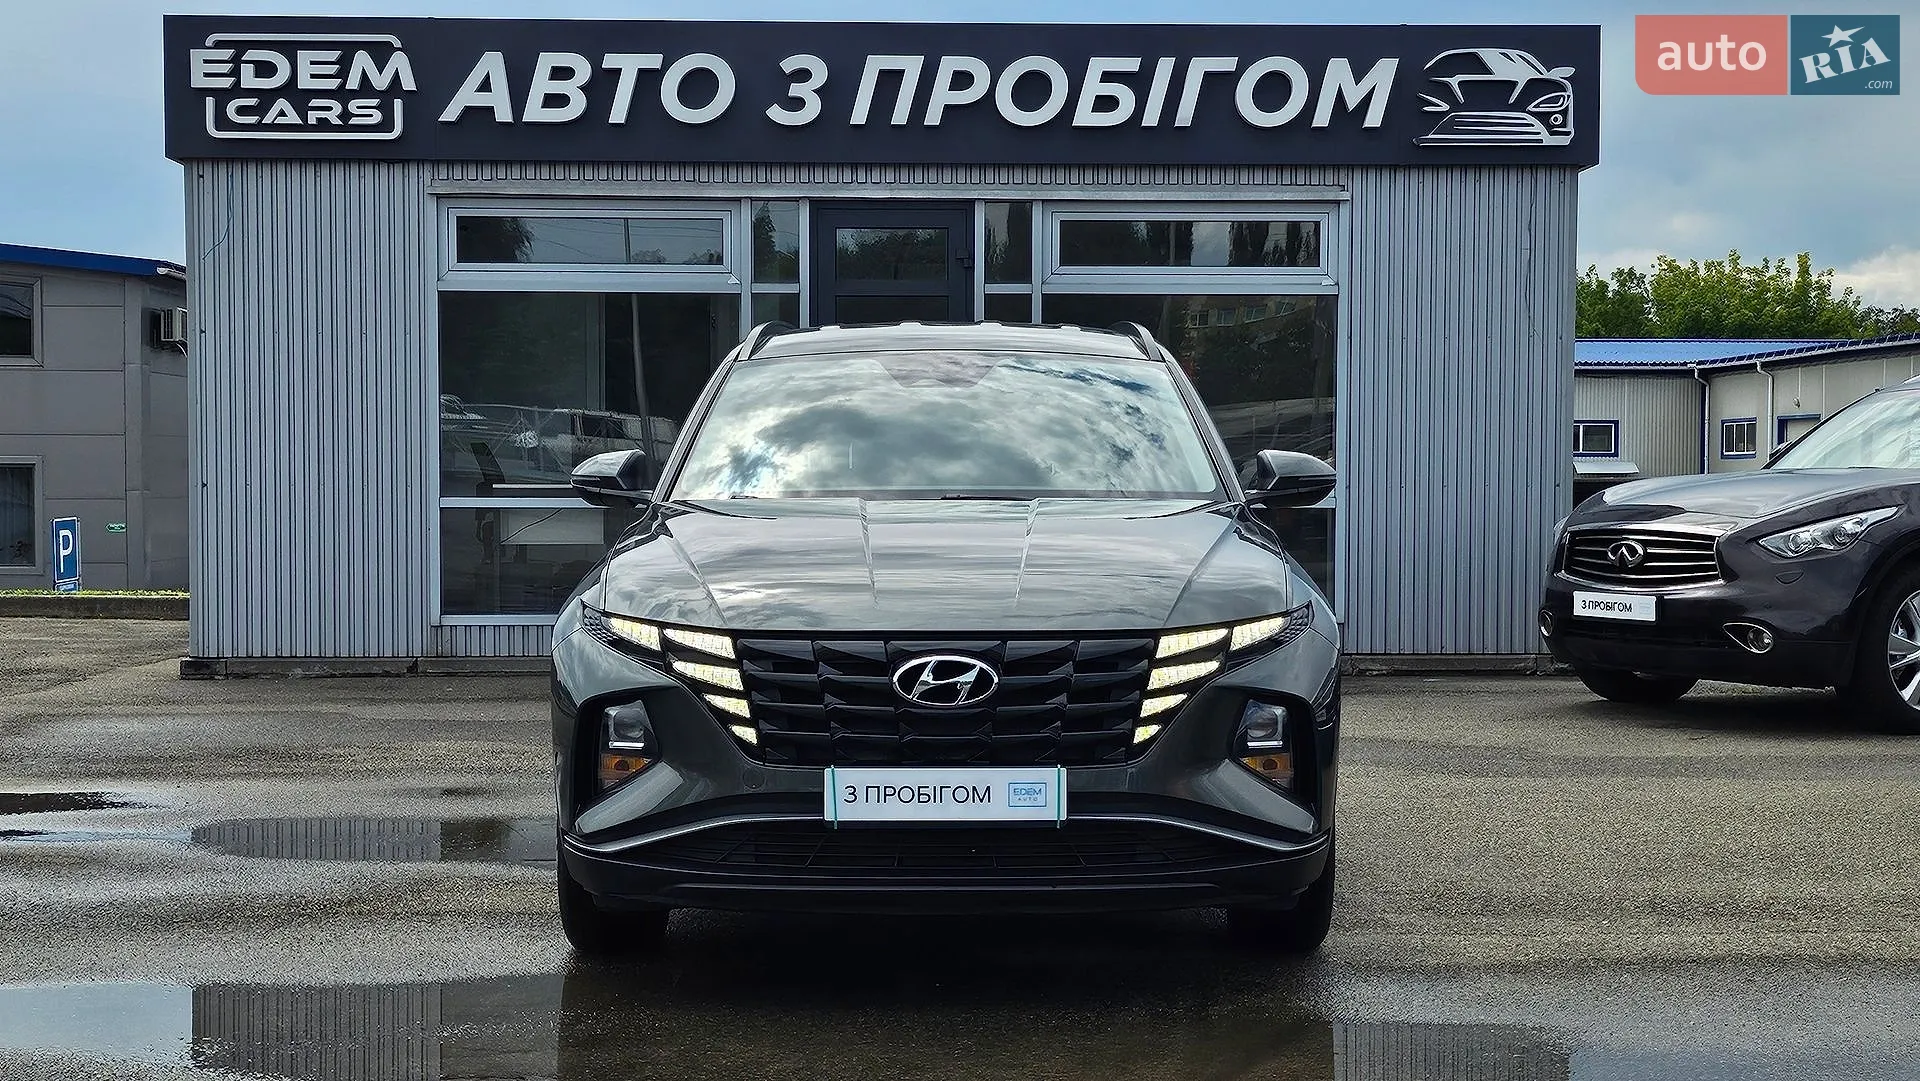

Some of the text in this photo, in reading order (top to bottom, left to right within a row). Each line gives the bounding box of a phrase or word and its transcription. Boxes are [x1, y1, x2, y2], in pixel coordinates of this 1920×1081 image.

[190, 48, 418, 92] EDEM
[438, 51, 1400, 129] АВТО З ПРОБІГОМ
[226, 97, 384, 125] CARS
[59, 529, 73, 573] P
[1588, 601, 1632, 612] ПРОБІГОМ
[843, 784, 992, 804] З ПРОБІГОМ
[1013, 787, 1042, 796] EDEM
